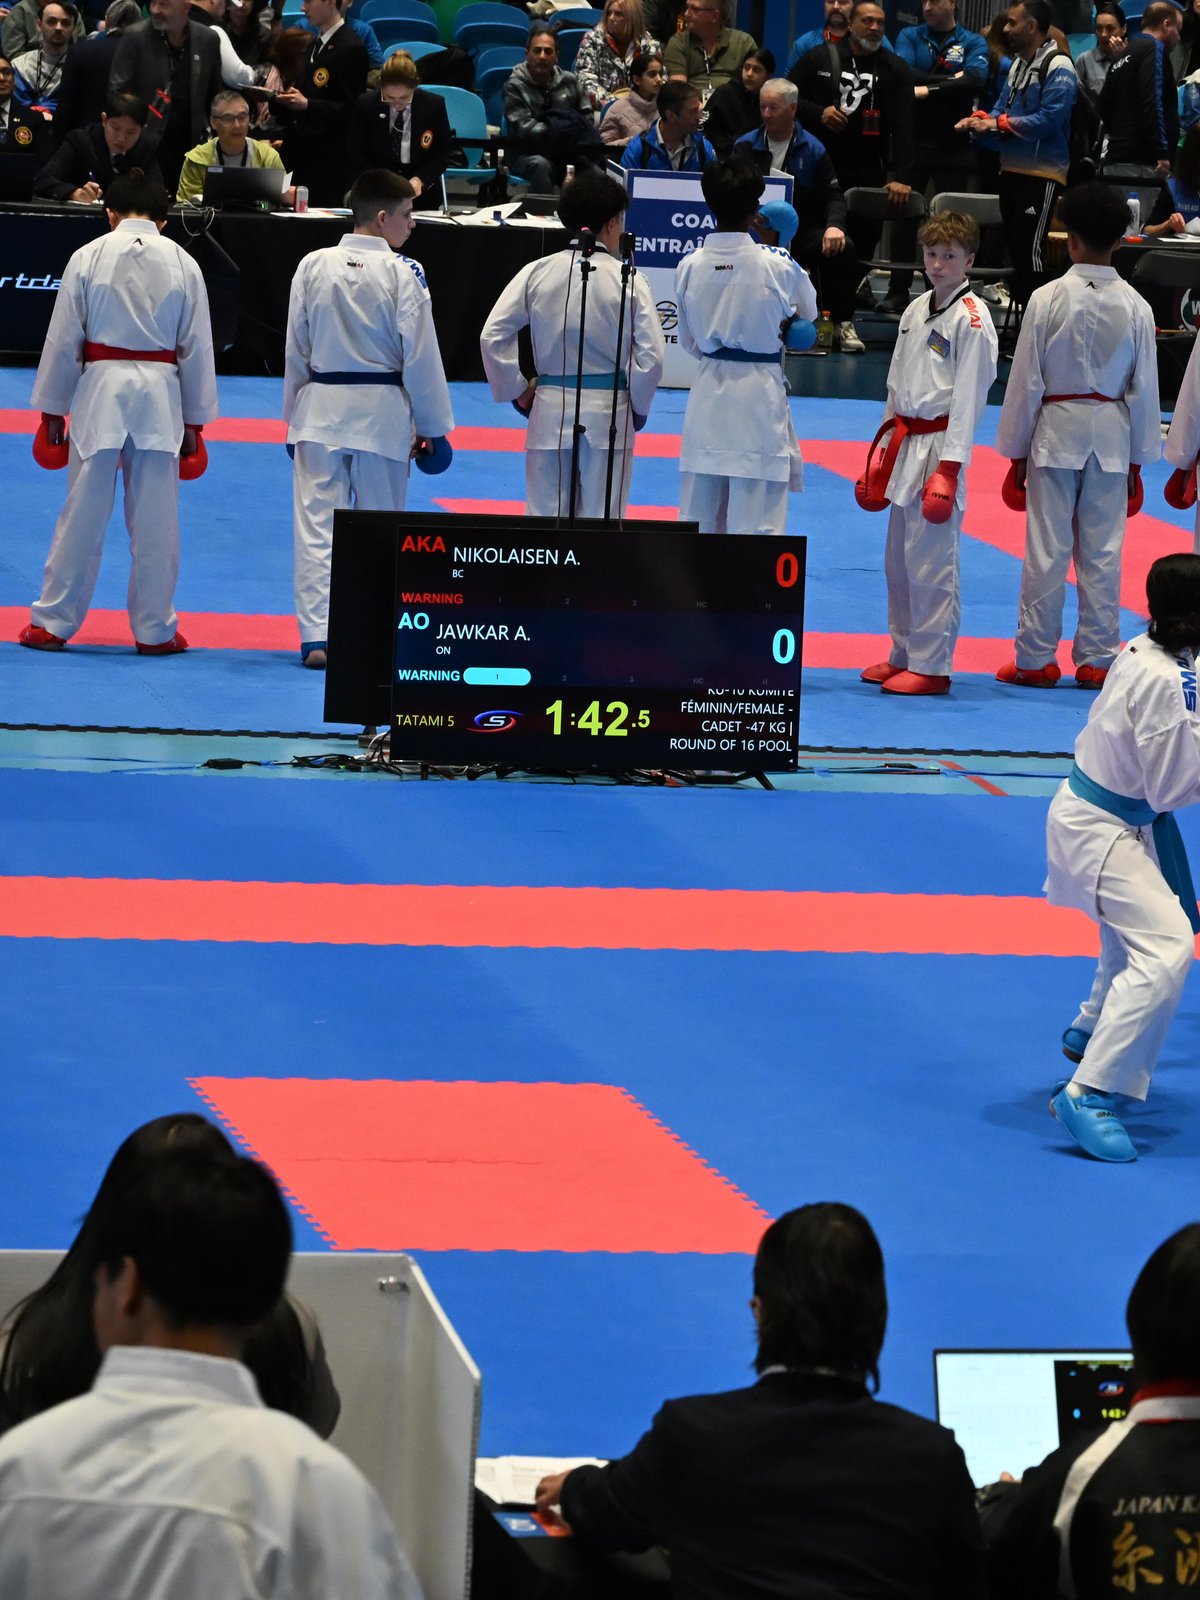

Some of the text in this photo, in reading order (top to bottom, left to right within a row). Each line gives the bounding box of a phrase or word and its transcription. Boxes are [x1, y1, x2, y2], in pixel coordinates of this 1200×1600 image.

[671, 212, 718, 229] COA
[635, 236, 704, 254] ENTRAÎ
[962, 297, 982, 329] SMAI
[401, 535, 447, 553] AKA
[453, 547, 581, 566] NIKOLAISEN A.
[452, 569, 464, 578] BC
[775, 552, 799, 588] 0
[401, 592, 464, 605] WARNING
[398, 612, 430, 630] AO
[436, 623, 531, 641] JAWKAR A.
[436, 646, 451, 655] ON
[772, 628, 796, 665] 0
[398, 669, 461, 682] WARNING
[681, 699, 785, 715] FÉMININ/FEMALE
[396, 714, 455, 727] TATAMI 5
[545, 700, 650, 736] 1:42.5
[701, 720, 742, 732] CADET
[745, 721, 765, 733] -47
[769, 721, 786, 734] KG
[670, 738, 792, 752] ROUND OF 16 POOL
[1112, 1495, 1178, 1516] JAPAN
